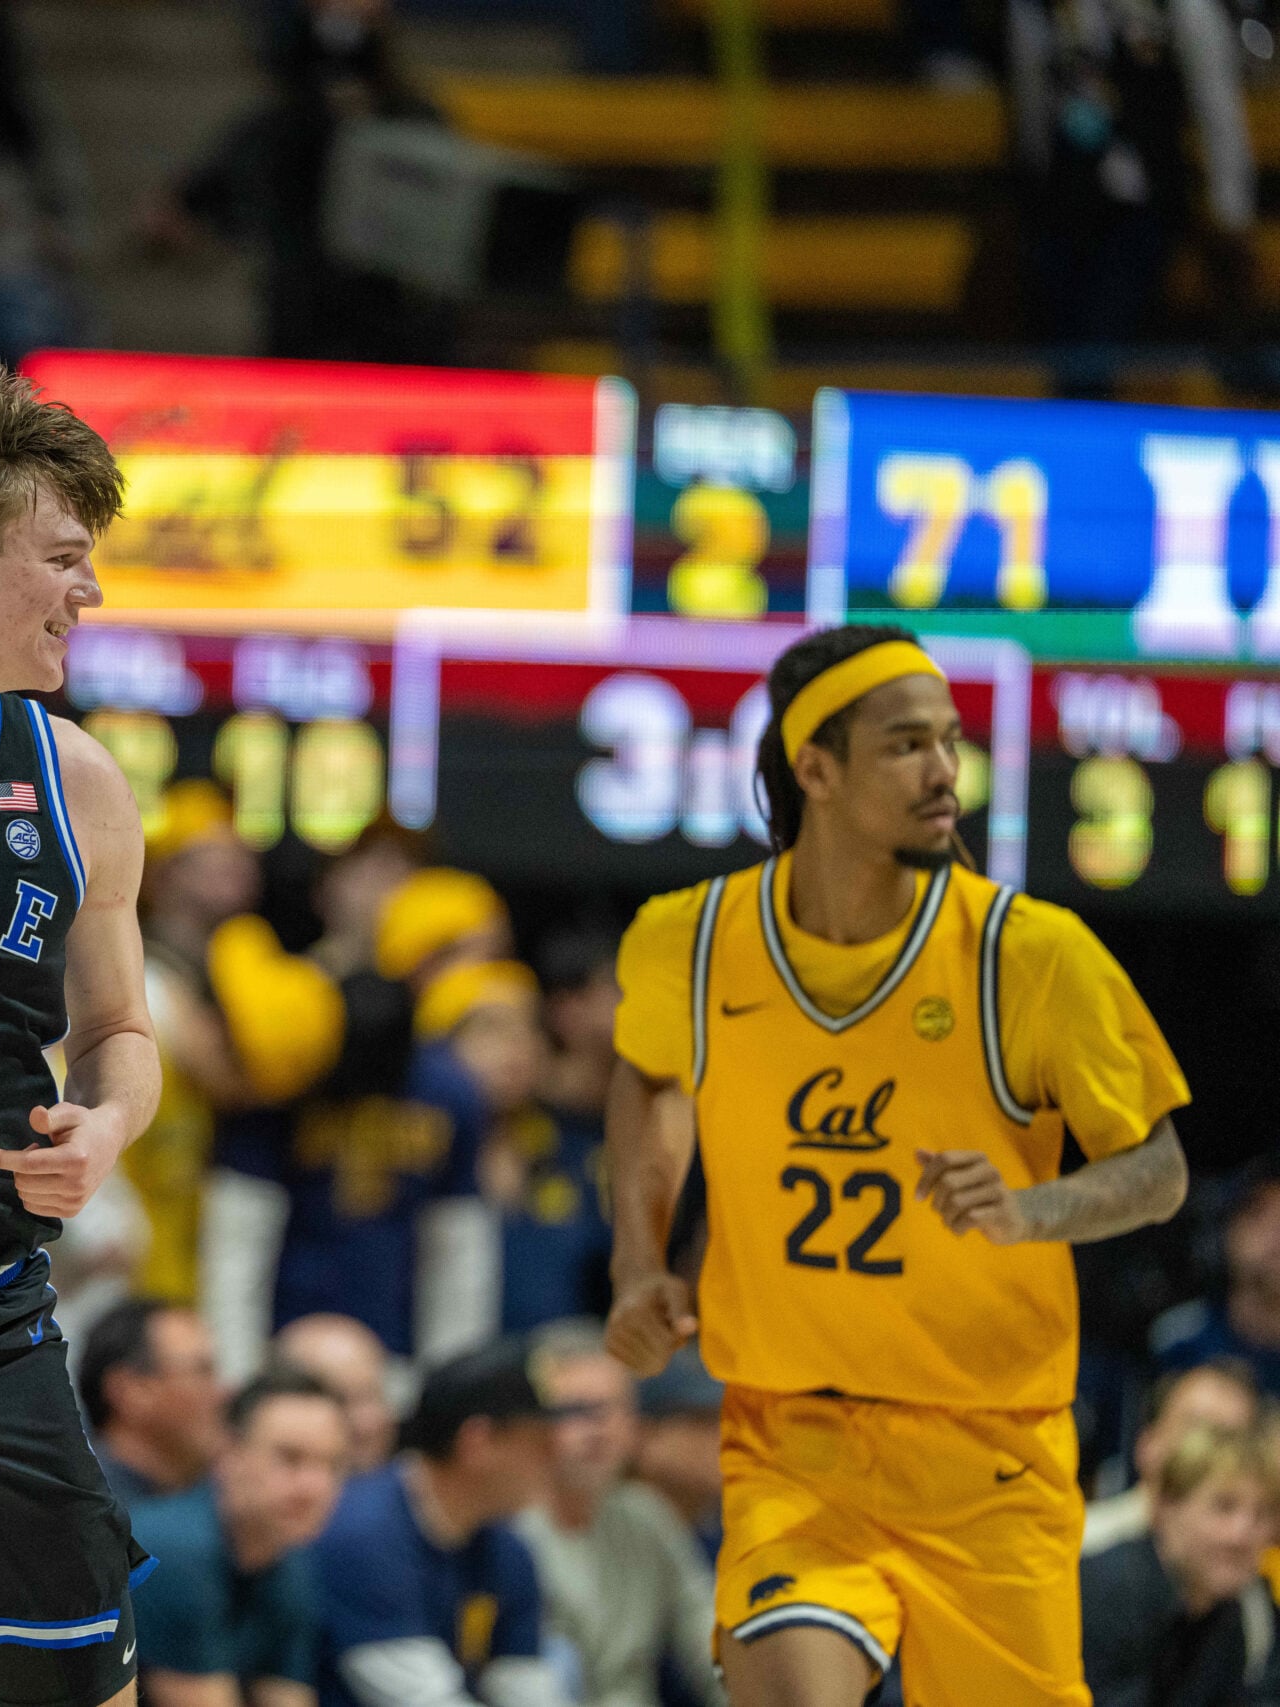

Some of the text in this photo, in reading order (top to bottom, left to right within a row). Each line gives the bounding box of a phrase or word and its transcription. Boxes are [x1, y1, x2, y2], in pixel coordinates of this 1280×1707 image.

[398, 435, 545, 568] 52
[877, 452, 1048, 611] 71
[213, 710, 386, 853] 10
[1068, 752, 1154, 890] 3
[786, 1066, 897, 1151] Cal
[780, 1164, 904, 1278] 22
